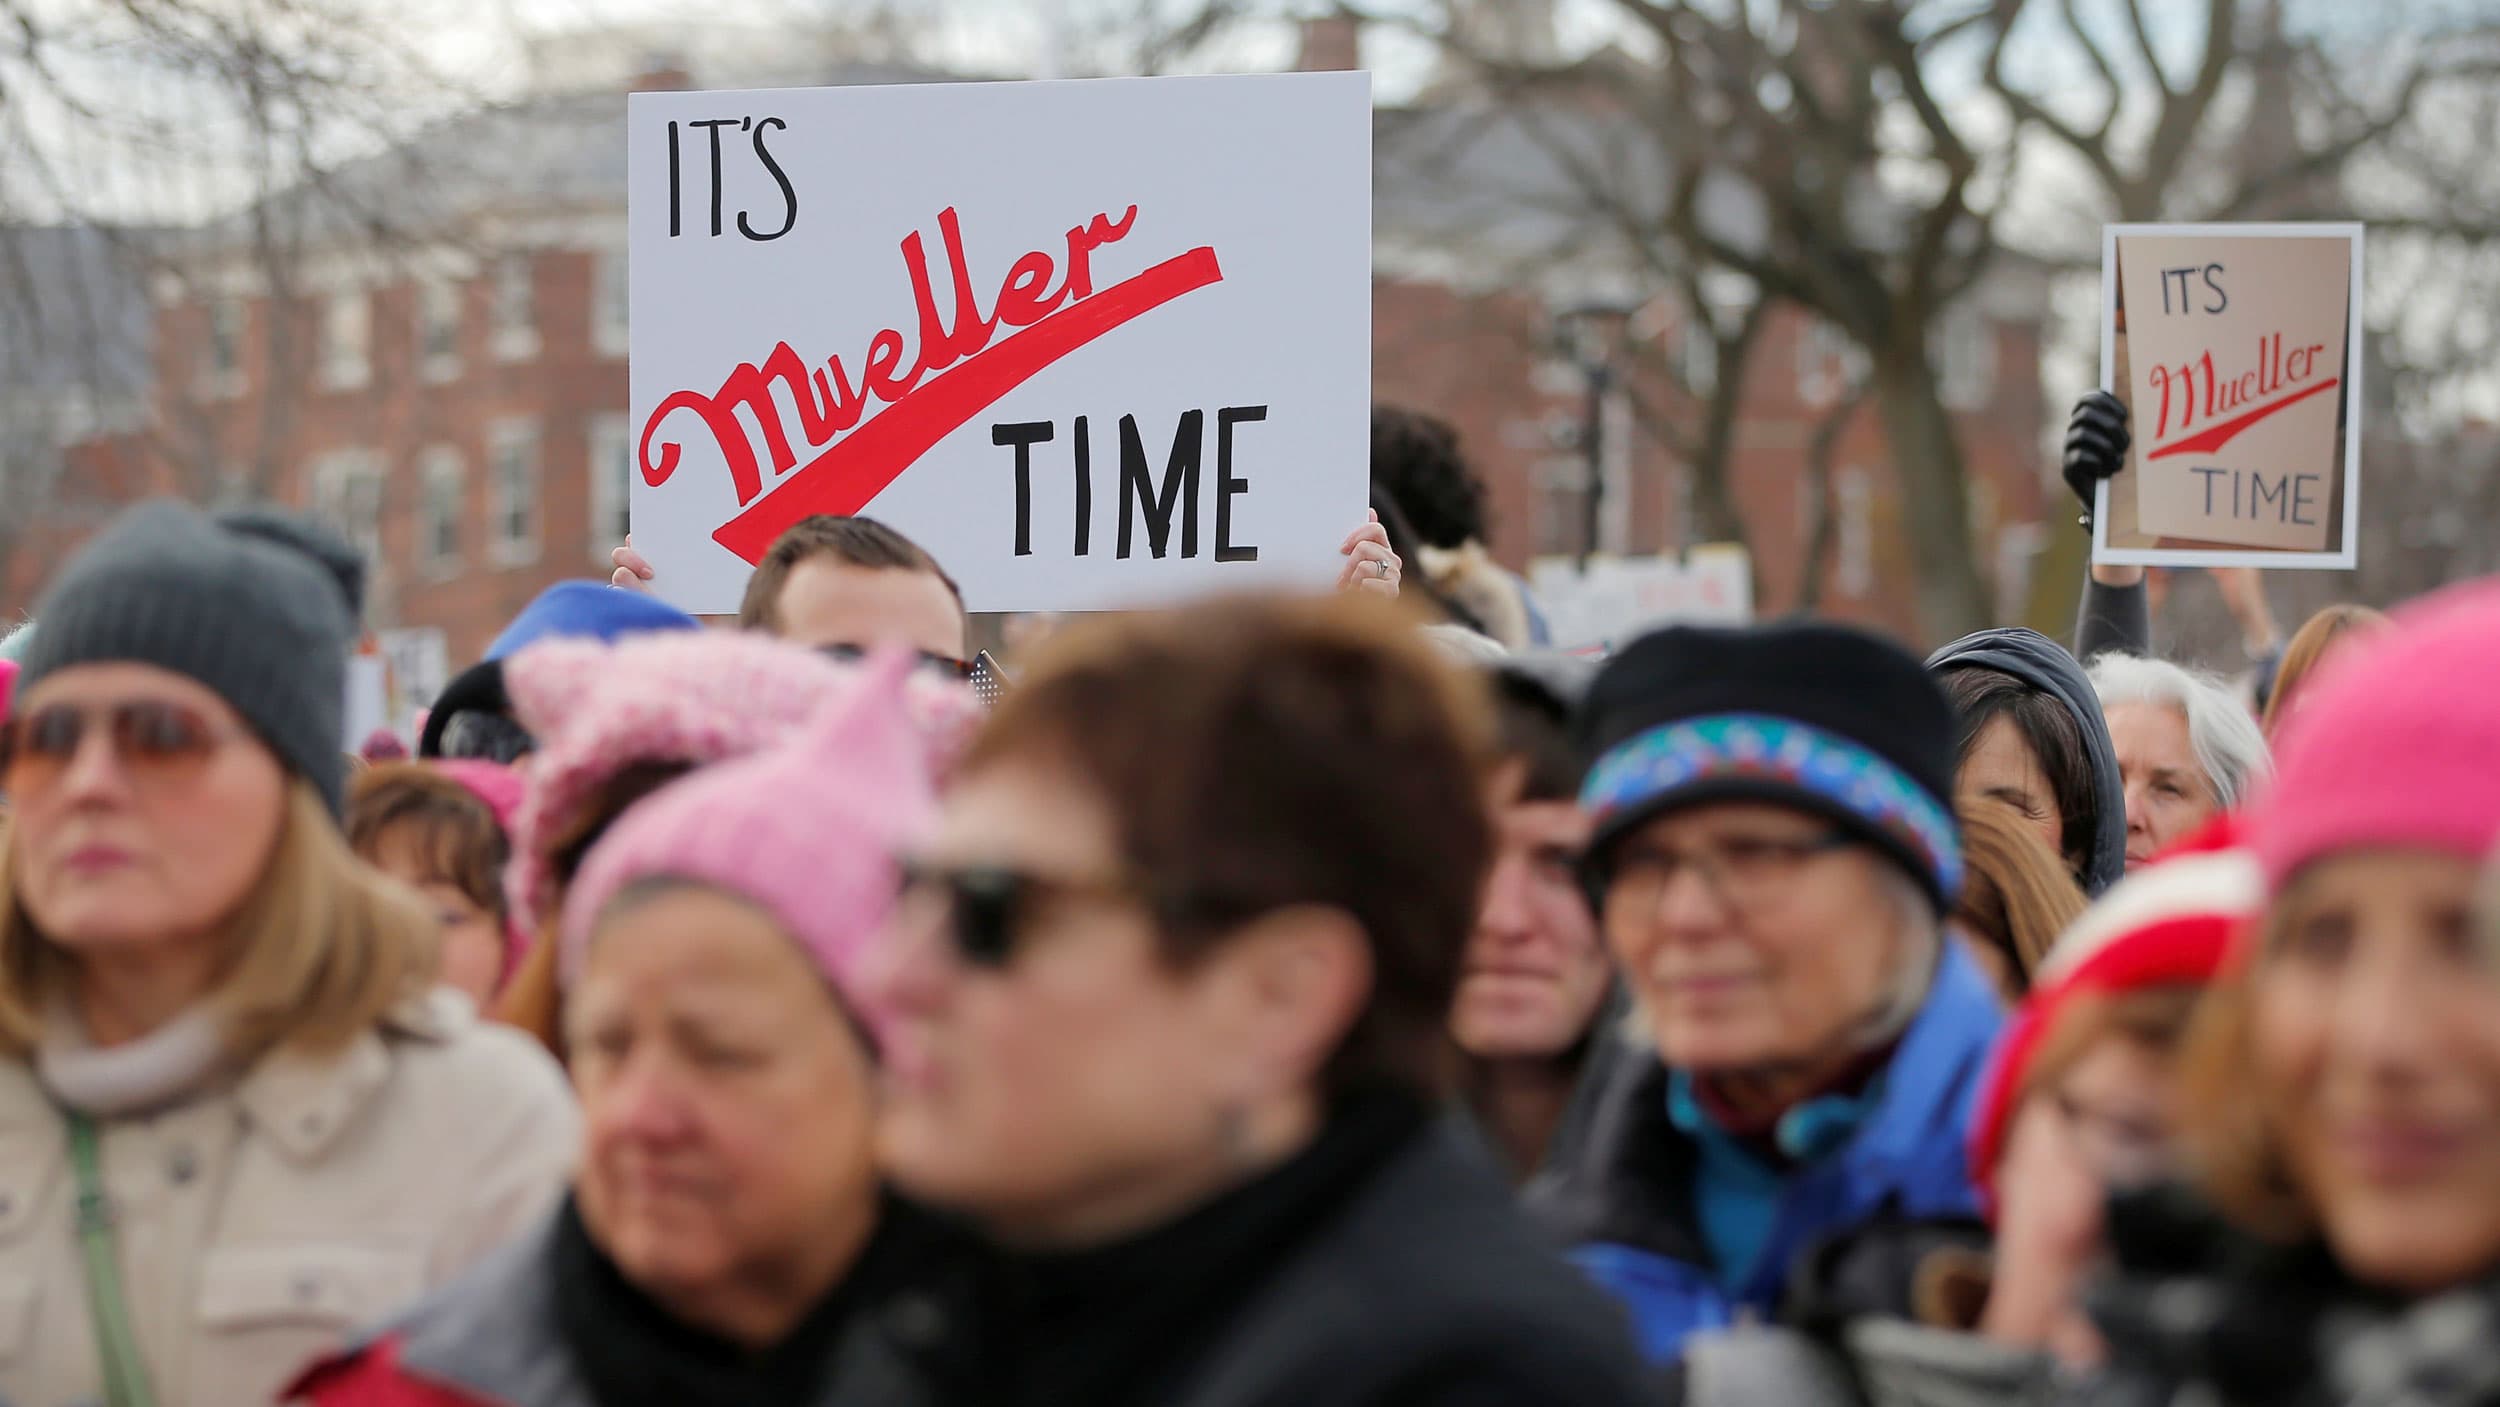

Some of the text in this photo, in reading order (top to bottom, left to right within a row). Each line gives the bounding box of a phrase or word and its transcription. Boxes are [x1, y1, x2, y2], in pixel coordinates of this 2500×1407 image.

[668, 116, 798, 241] IT'S
[638, 204, 1138, 508] Mueller
[2150, 331, 2325, 440] Mueller
[992, 404, 1268, 563] TIME
[2190, 466, 2320, 526] TIME
